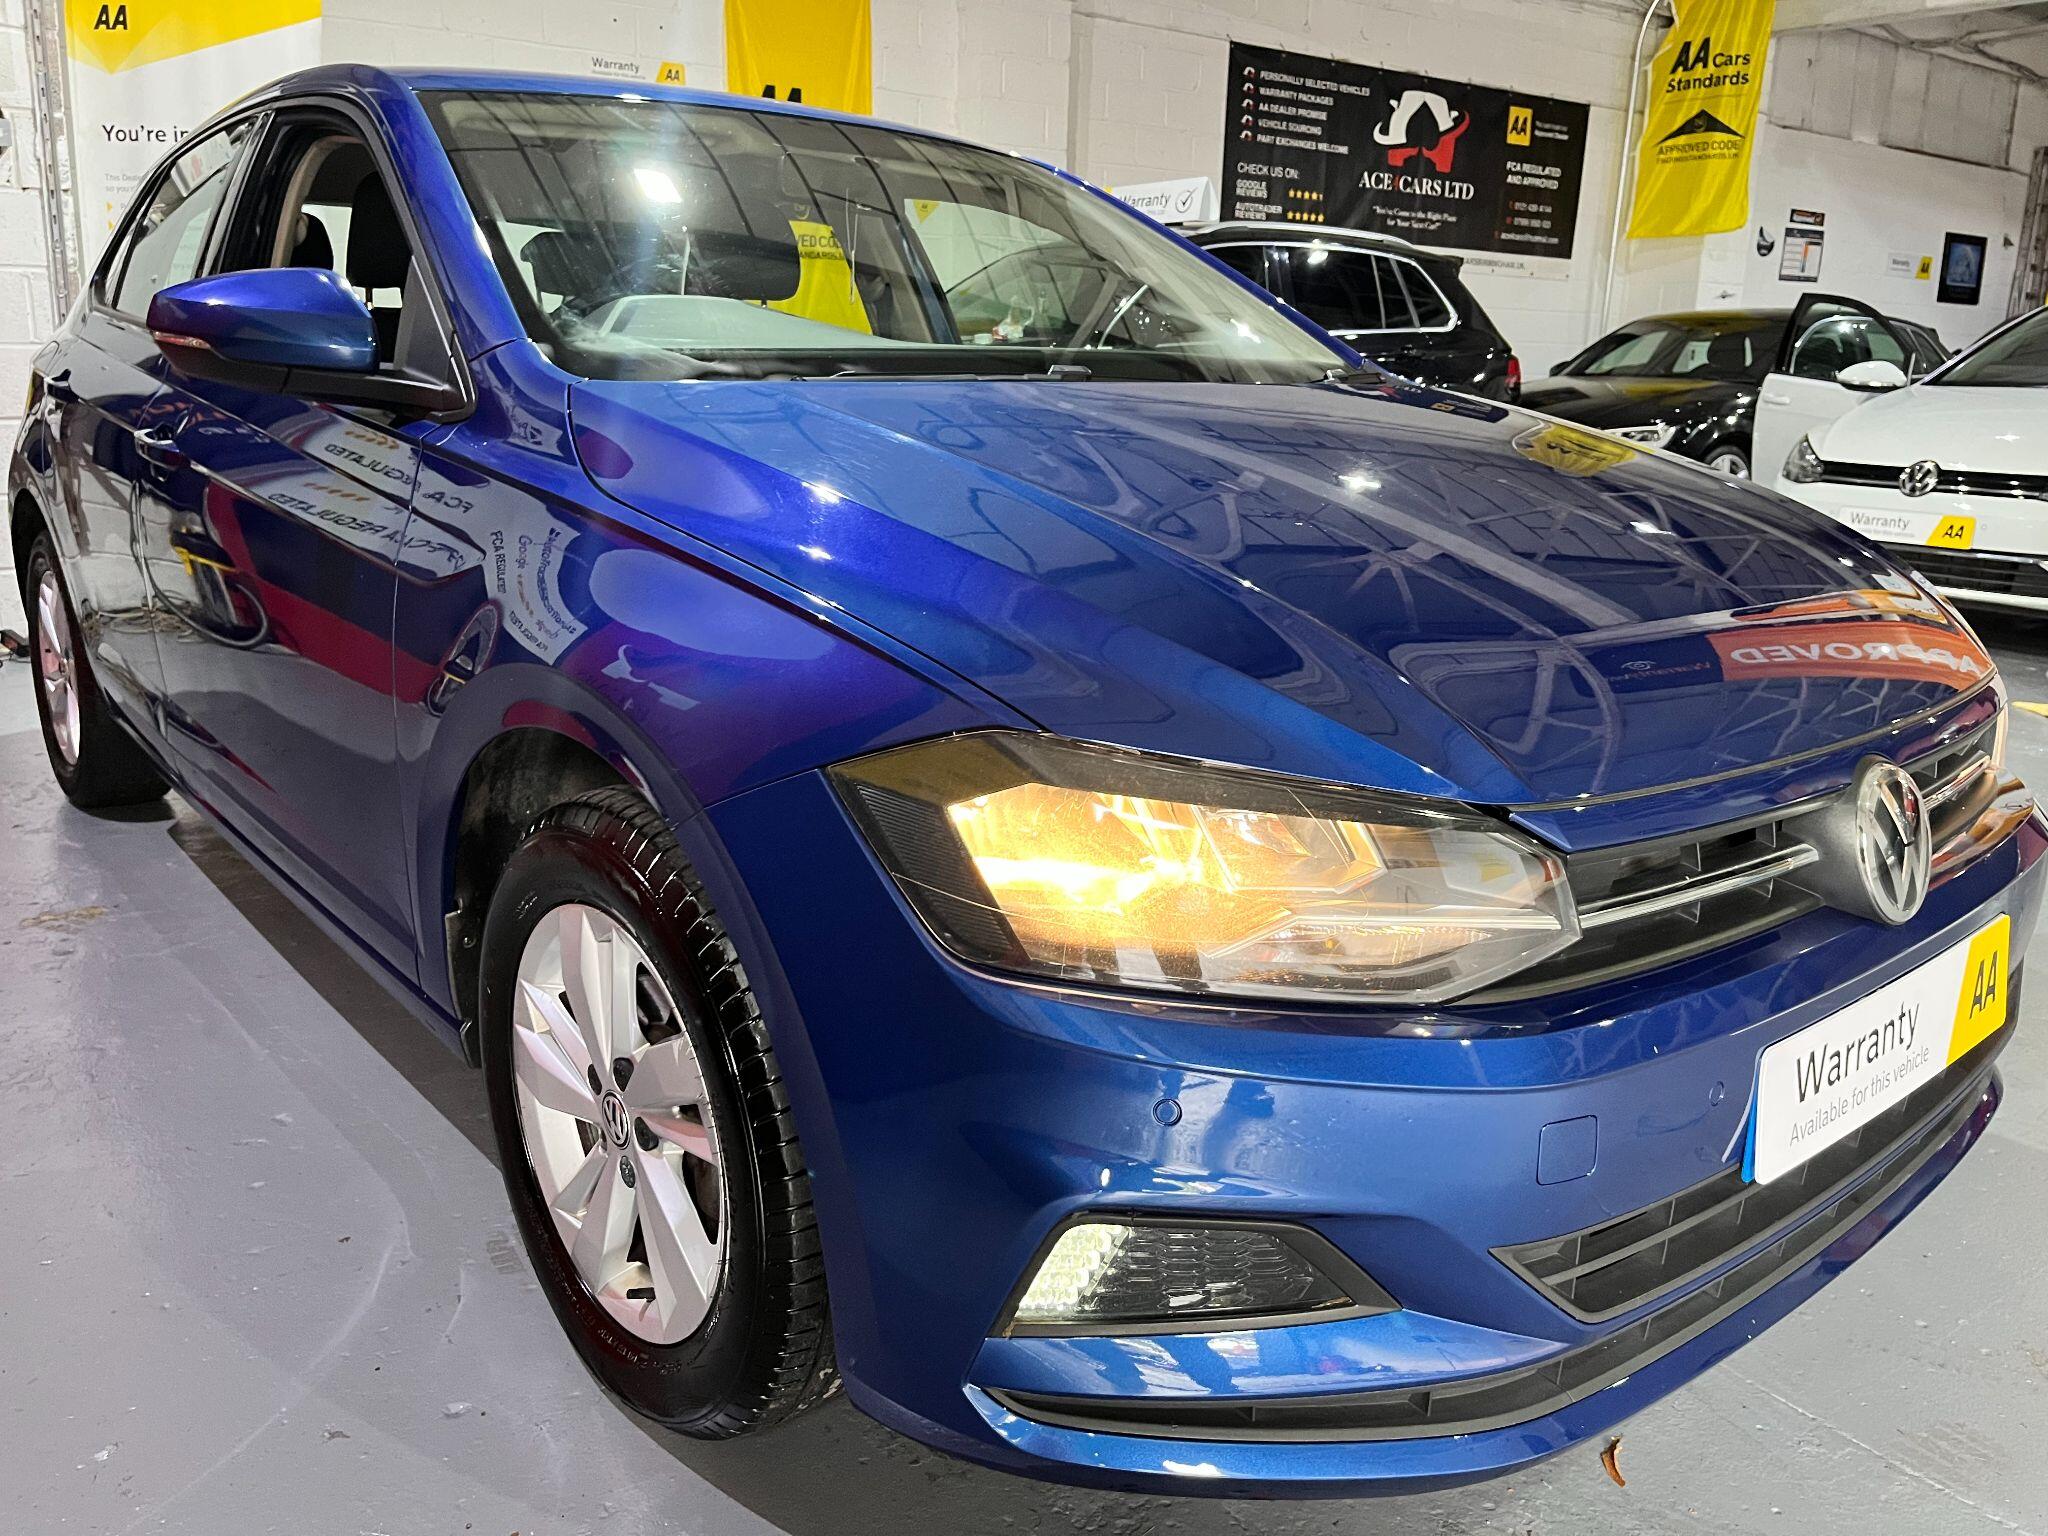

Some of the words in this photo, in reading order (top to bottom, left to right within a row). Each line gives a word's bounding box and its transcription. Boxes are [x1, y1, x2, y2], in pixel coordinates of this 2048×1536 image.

[94, 4, 128, 30] AA
[592, 57, 640, 73] Warranty
[1669, 37, 1710, 75] AA
[1713, 53, 1751, 68] Cars
[665, 69, 680, 81] AA
[1666, 71, 1749, 93] Standards
[1510, 116, 1528, 135] AA
[1237, 161, 1269, 175] CHECK
[1270, 166, 1283, 177] US
[1444, 180, 1475, 200] LTD
[1850, 511, 1910, 530] Warranty
[1943, 525, 1964, 539] AA
[1969, 950, 1998, 1020] AA
[1796, 1001, 1920, 1103] Warranty
[1789, 1097, 1849, 1148] Available
[1851, 1082, 1869, 1111] for
[1870, 1071, 1891, 1098] this
[1893, 1046, 1930, 1084] vehicle
